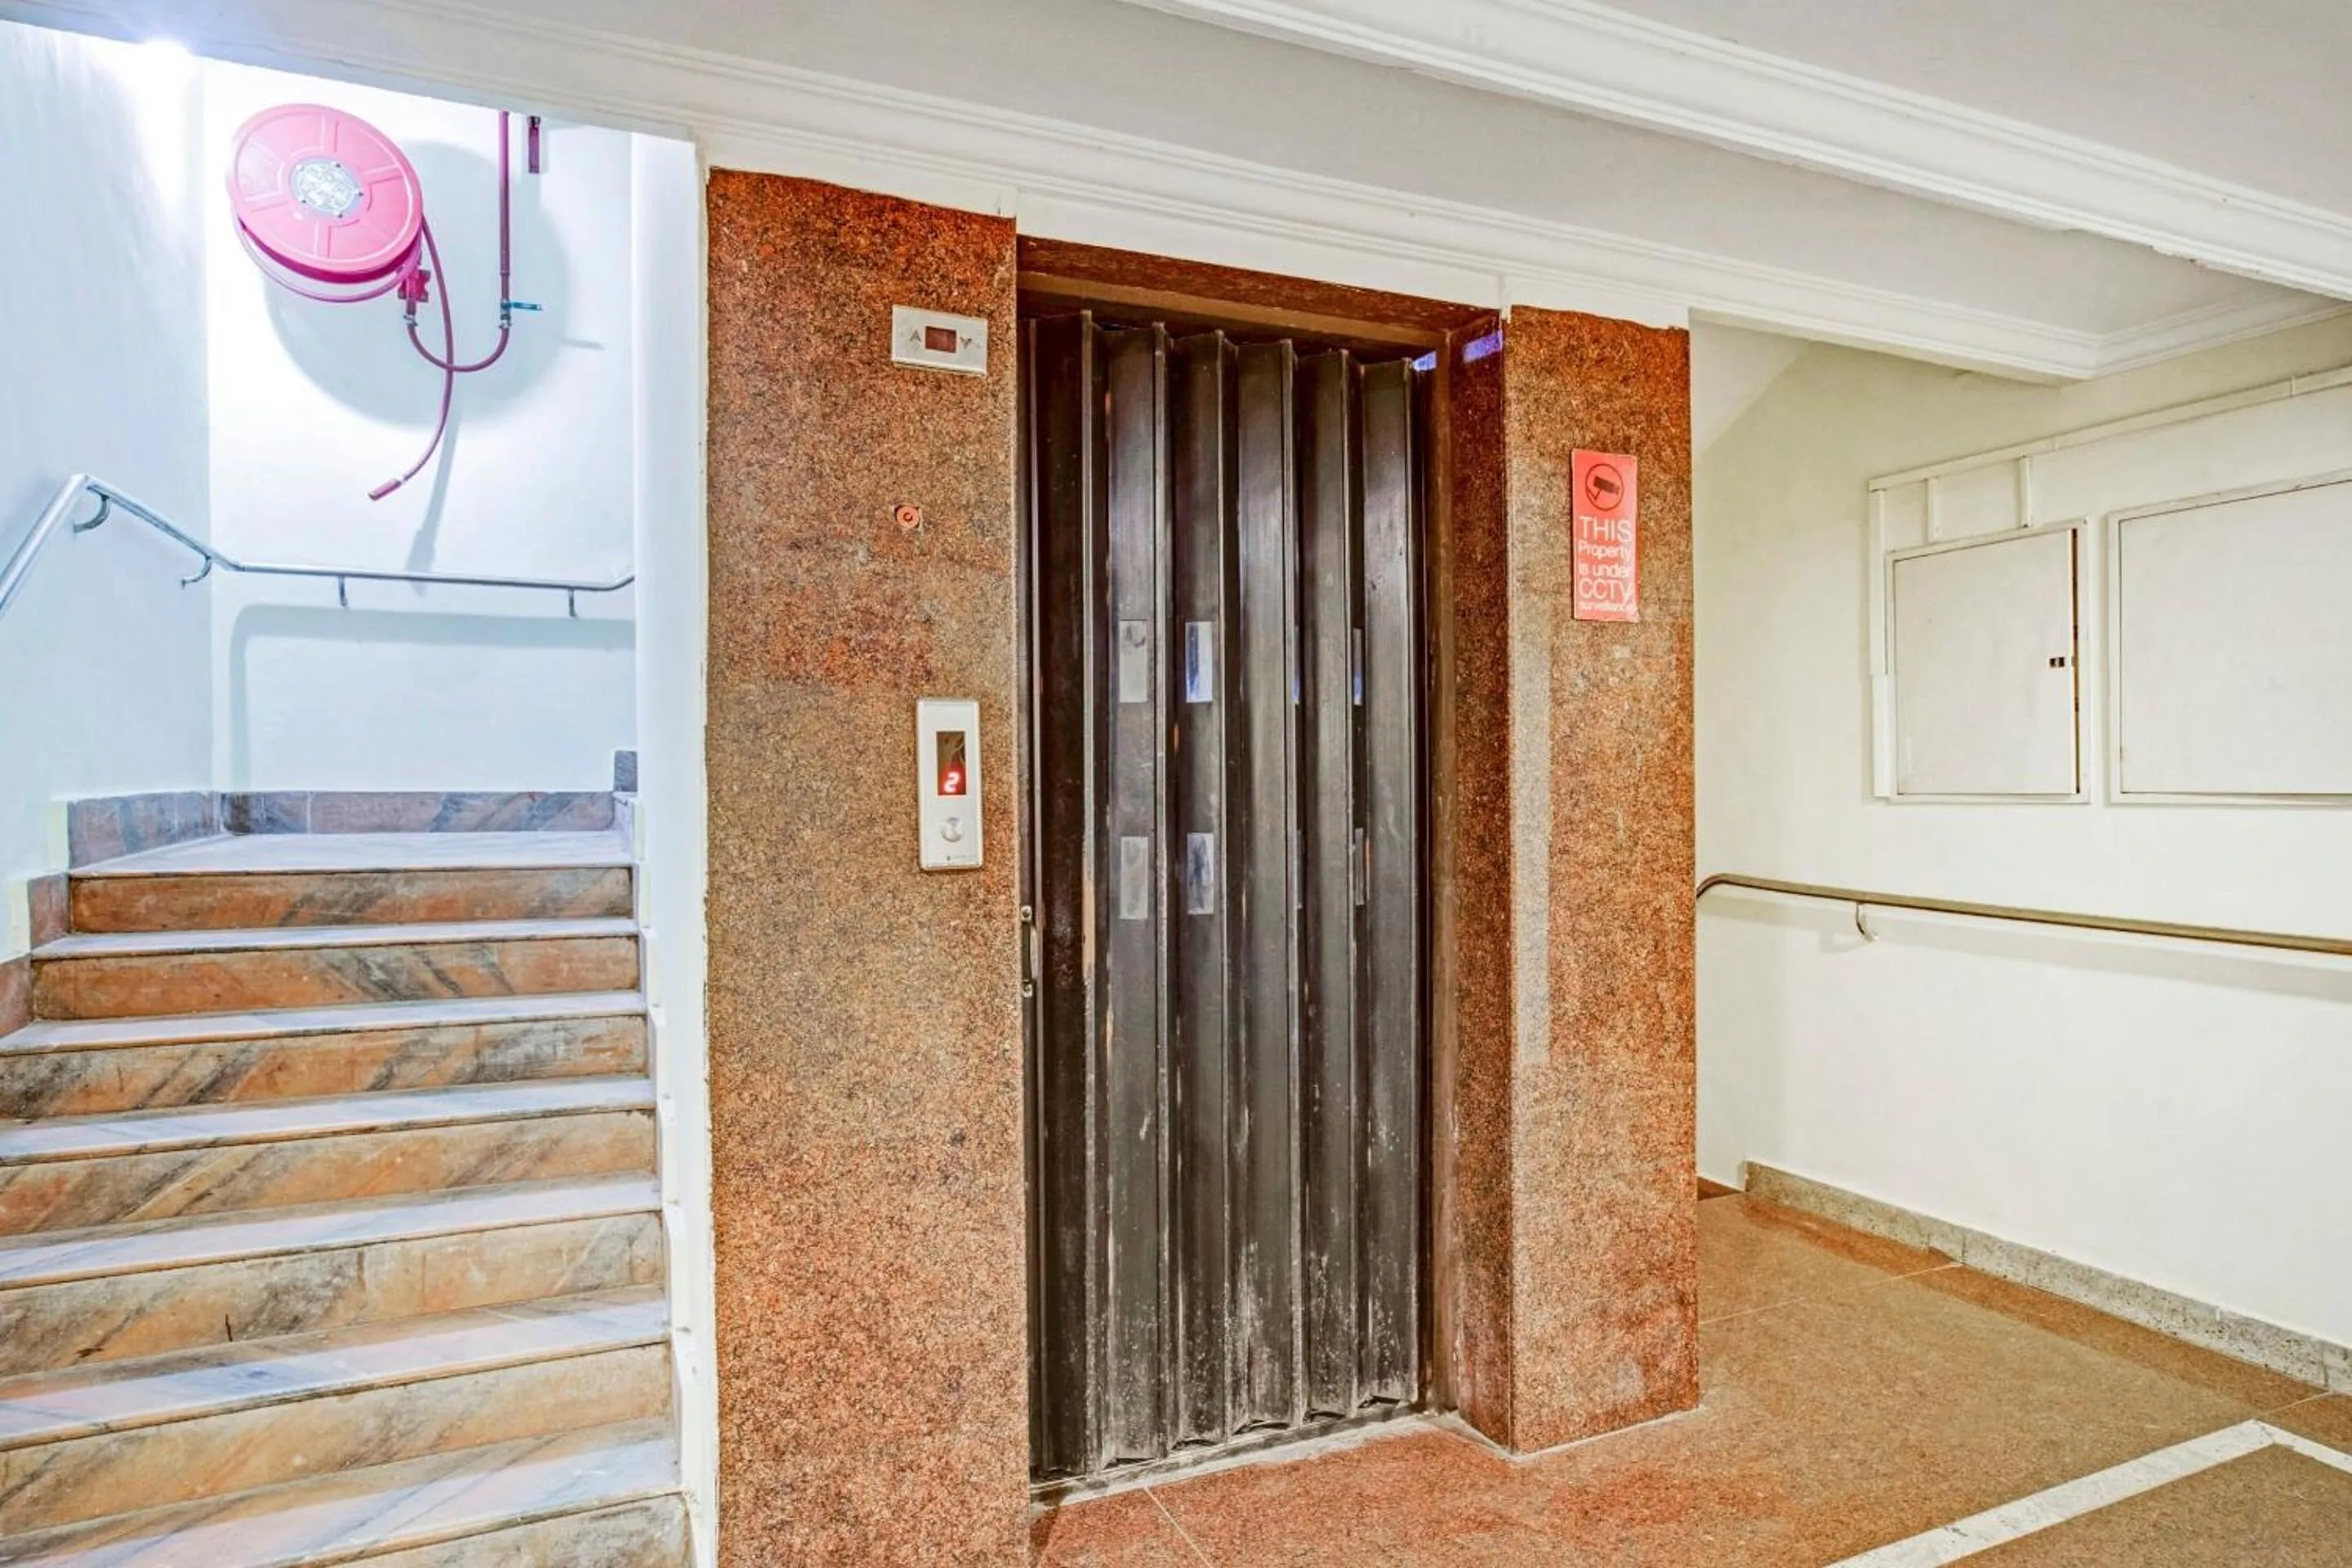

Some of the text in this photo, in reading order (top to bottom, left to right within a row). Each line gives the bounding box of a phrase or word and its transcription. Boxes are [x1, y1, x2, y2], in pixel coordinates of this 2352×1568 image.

[1579, 516, 1633, 542] THIS
[1579, 578, 1634, 603] CCTV
[944, 772, 961, 793] 2
